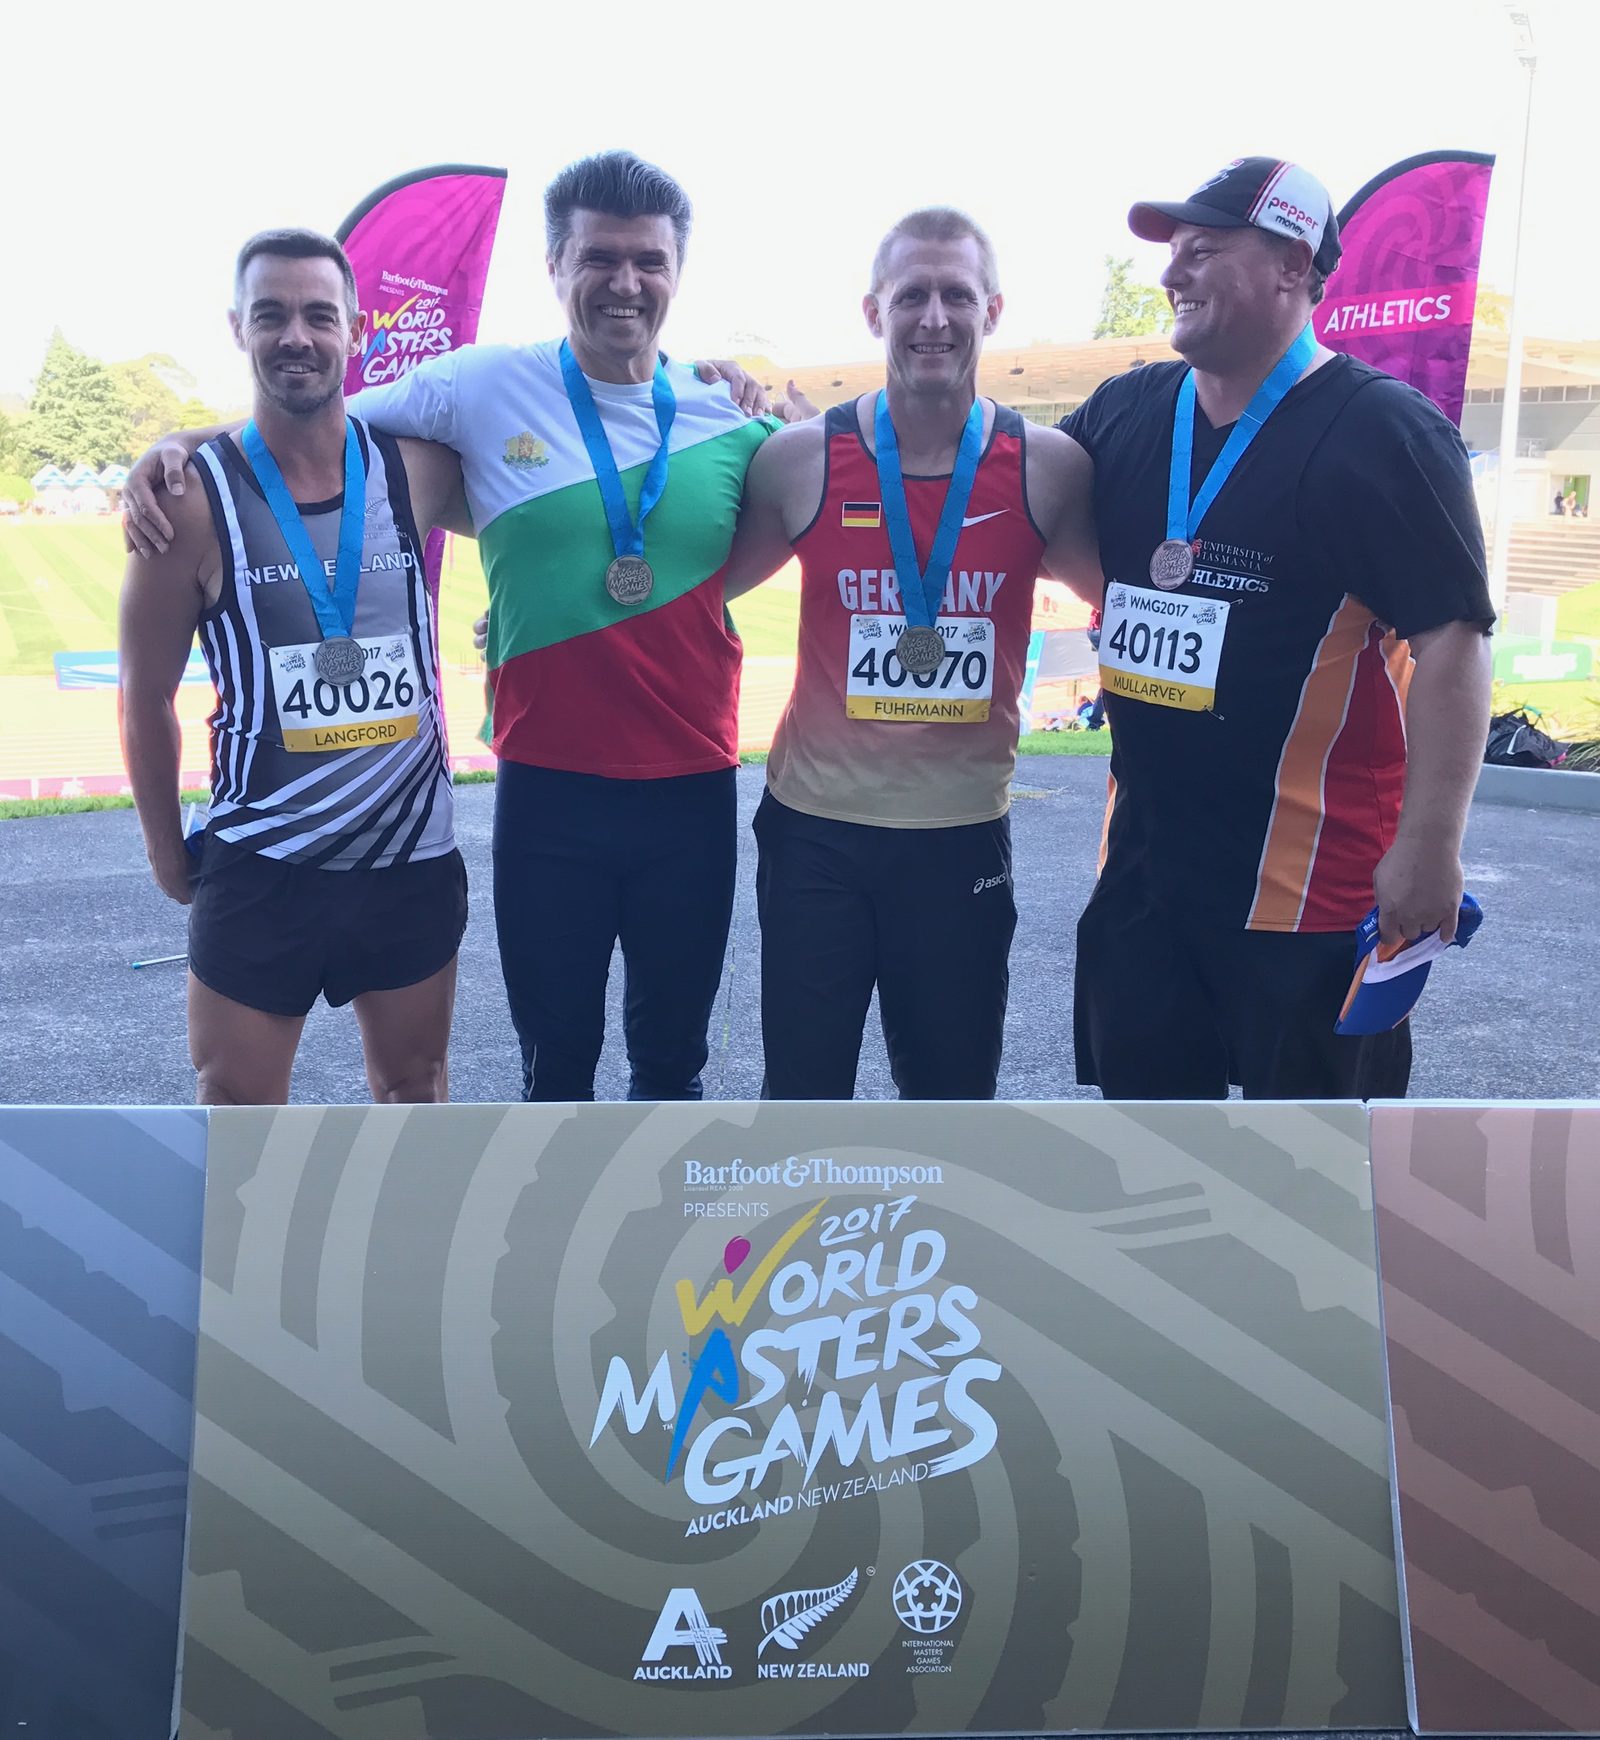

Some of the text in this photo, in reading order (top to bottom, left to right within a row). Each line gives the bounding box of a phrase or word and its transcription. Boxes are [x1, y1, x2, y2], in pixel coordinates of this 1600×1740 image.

[1268, 197, 1318, 230] pepper
[1276, 215, 1305, 237] money
[373, 292, 446, 330] WORLD
[1323, 294, 1452, 334] ATHLETICS
[363, 354, 438, 384] GAM
[1203, 540, 1275, 564] UNIVERSITY of
[1203, 551, 1261, 571] TASMANIA
[243, 552, 415, 586] NEW ELAND
[1187, 569, 1270, 593] HLETICS
[837, 567, 1006, 613] GERANY
[1130, 595, 1189, 618] WMG2017
[889, 623, 959, 639] W017
[1109, 618, 1203, 674] 40113
[282, 667, 414, 719] 40026
[1113, 674, 1187, 703] MULLARVEY
[874, 701, 964, 718] FUHRMANN
[315, 724, 397, 746] LANGFORD
[985, 872, 1006, 888] asics
[683, 1156, 944, 1191] Barfoot&Thompson
[683, 1202, 769, 1217] PRESENTS
[818, 1195, 918, 1246] 2017
[675, 1196, 946, 1336] WORLD
[589, 1285, 982, 1484] MASTERS
[683, 1358, 1002, 1504] GAMES
[684, 1463, 930, 1537] AUCKLAND NEW ZEALAND
[902, 1640, 954, 1648] INTERNATIONAL
[913, 1648, 943, 1656] MASTERS
[633, 1665, 733, 1680] AUCKLAND
[757, 1663, 870, 1679] NEW ZEALAND
[905, 1665, 952, 1673] ASSOCIATION
[916, 1657, 941, 1665] GAMES
